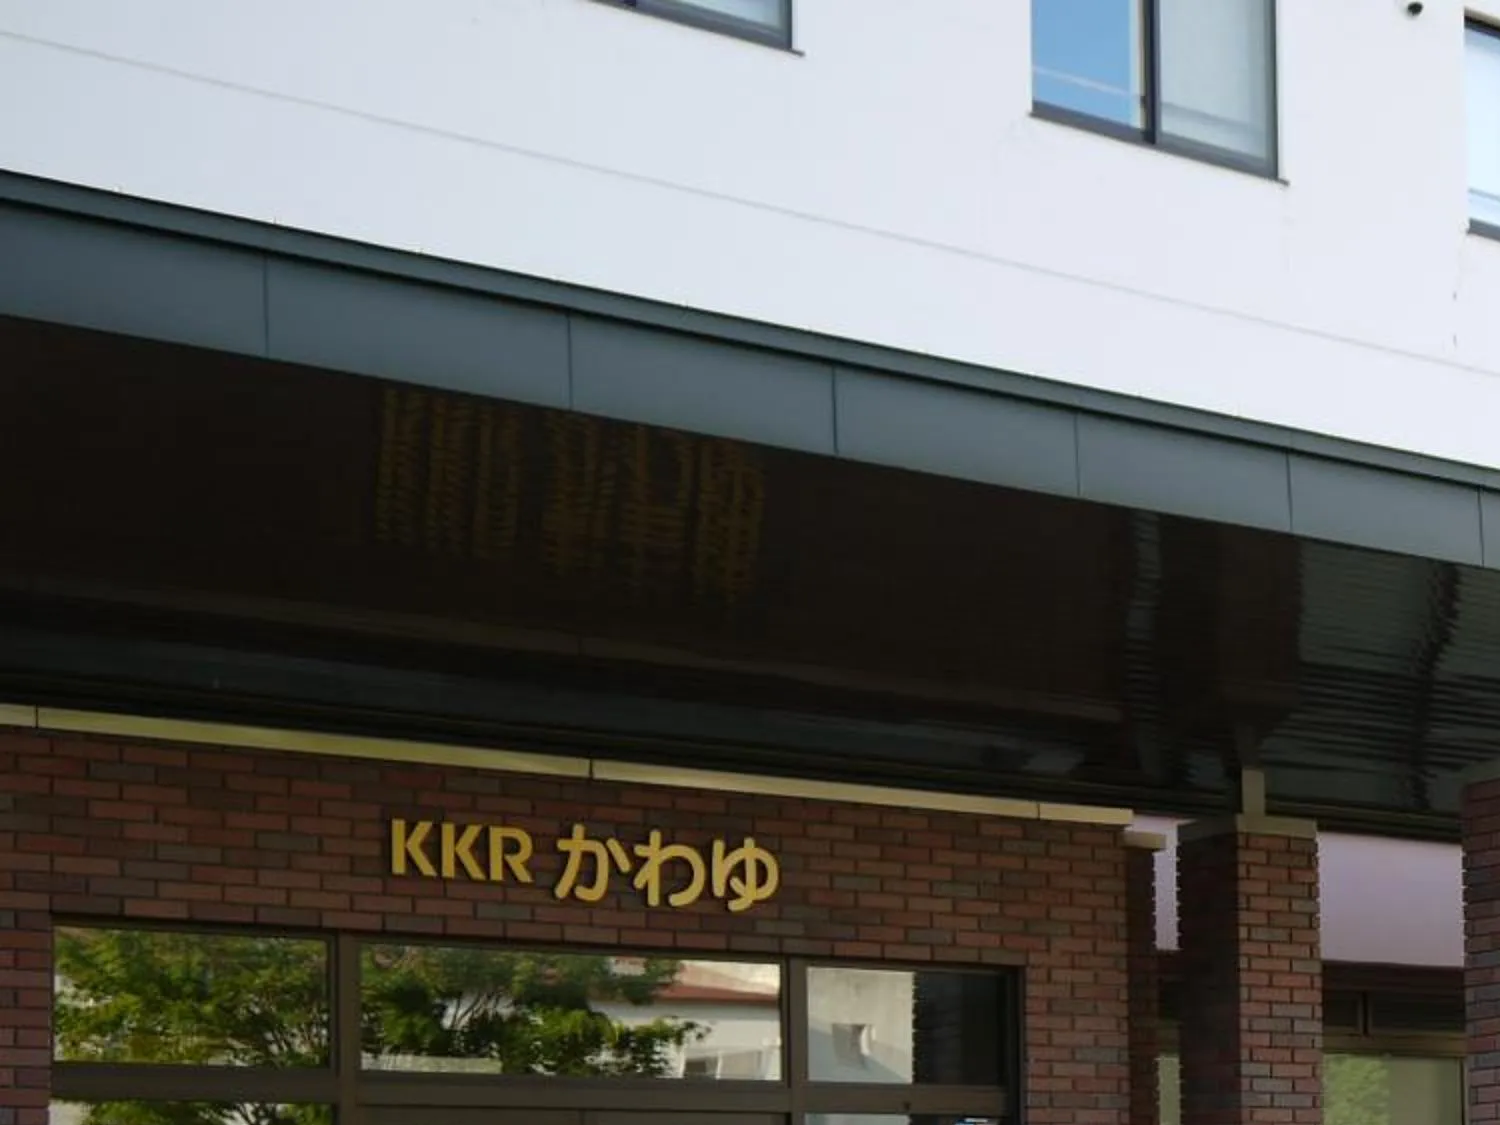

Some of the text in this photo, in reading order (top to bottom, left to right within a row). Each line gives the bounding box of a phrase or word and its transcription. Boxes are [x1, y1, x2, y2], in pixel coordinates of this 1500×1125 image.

[391, 818, 781, 912] KKR かわゆ
